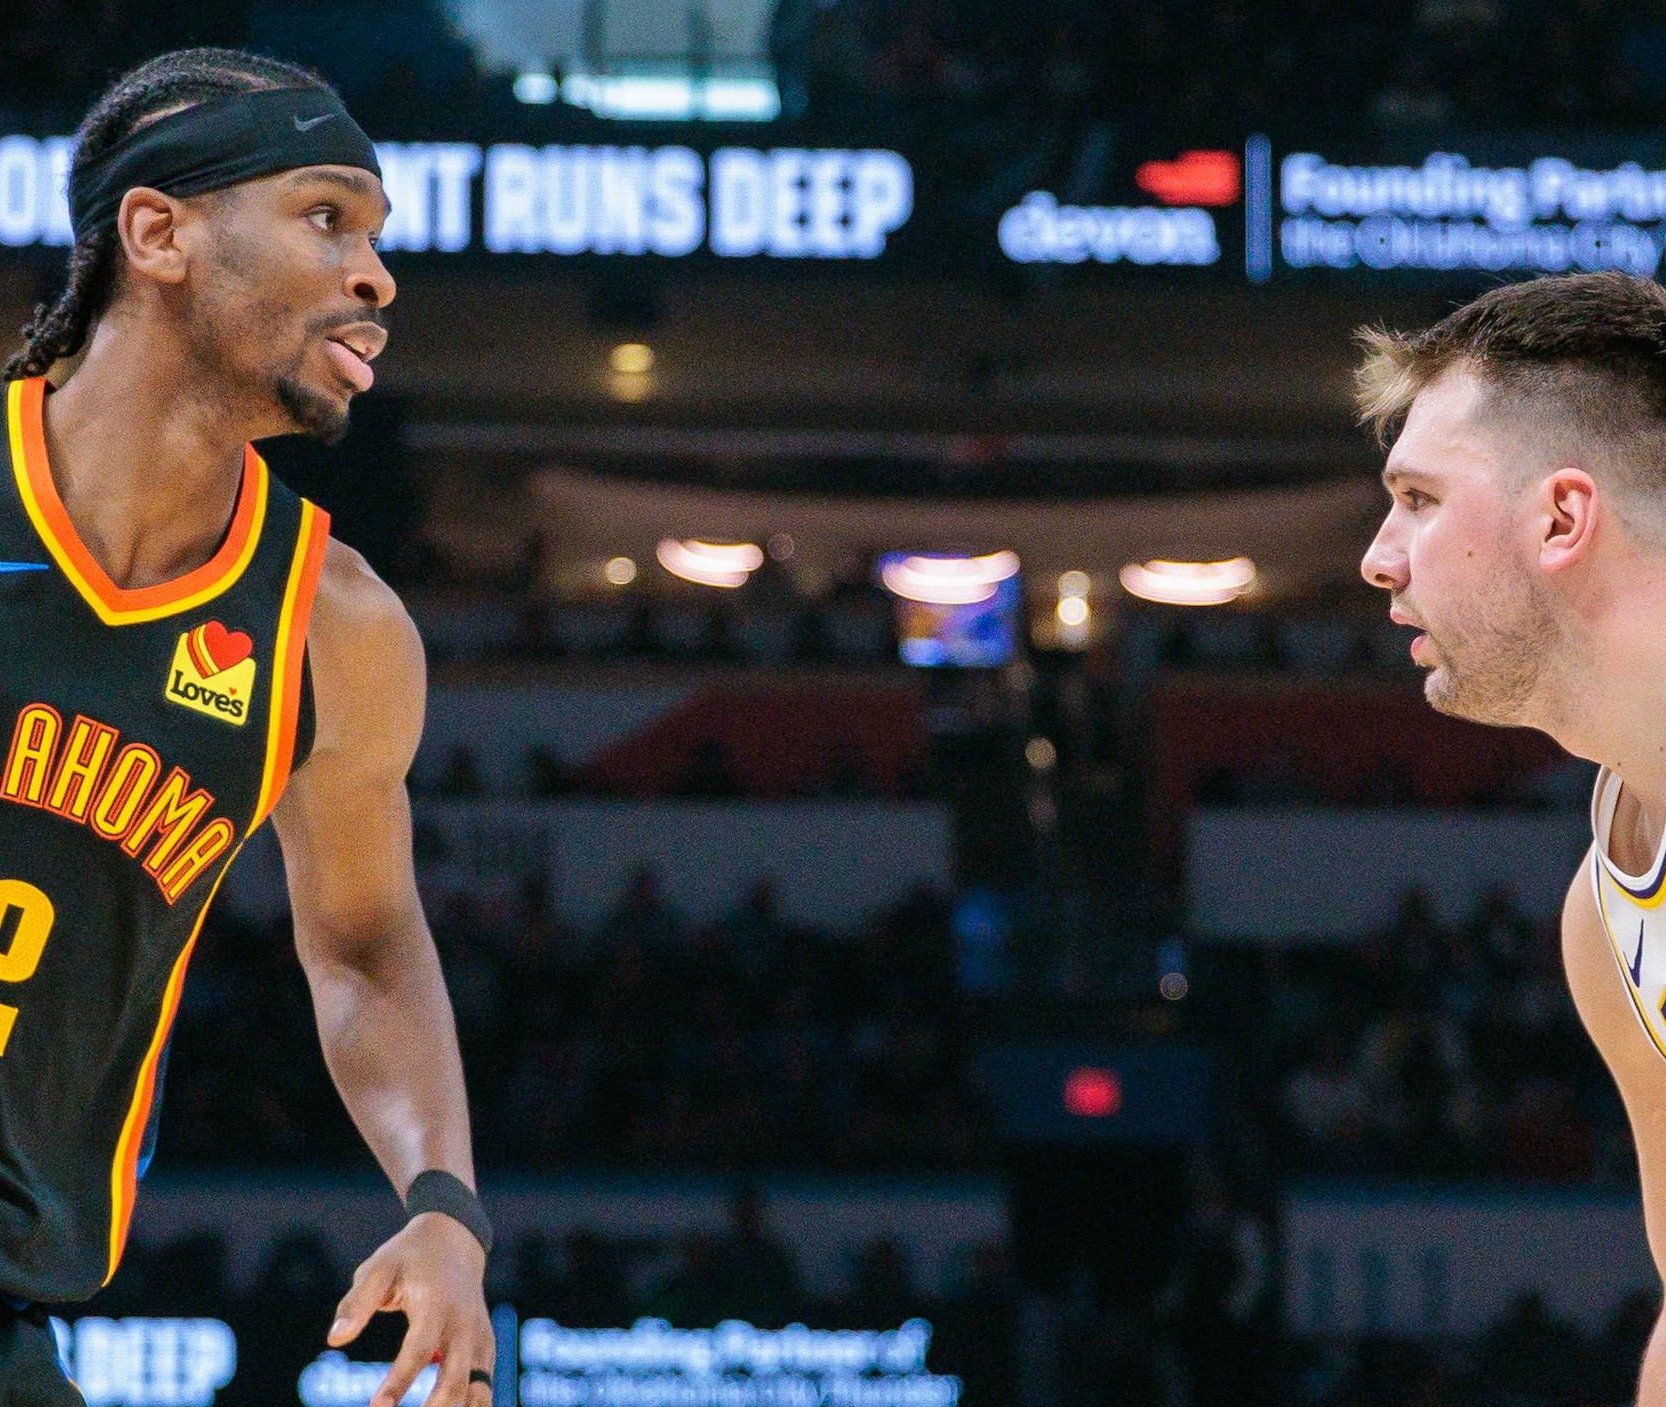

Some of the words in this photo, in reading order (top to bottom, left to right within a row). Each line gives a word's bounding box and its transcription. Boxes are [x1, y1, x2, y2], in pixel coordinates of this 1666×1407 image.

[483, 143, 705, 256] RUNS
[708, 146, 913, 259] DEEP
[998, 190, 1219, 264] devon
[1280, 153, 1531, 233] Founding
[1353, 213, 1570, 270] Oklahoma
[1568, 217, 1662, 276] City
